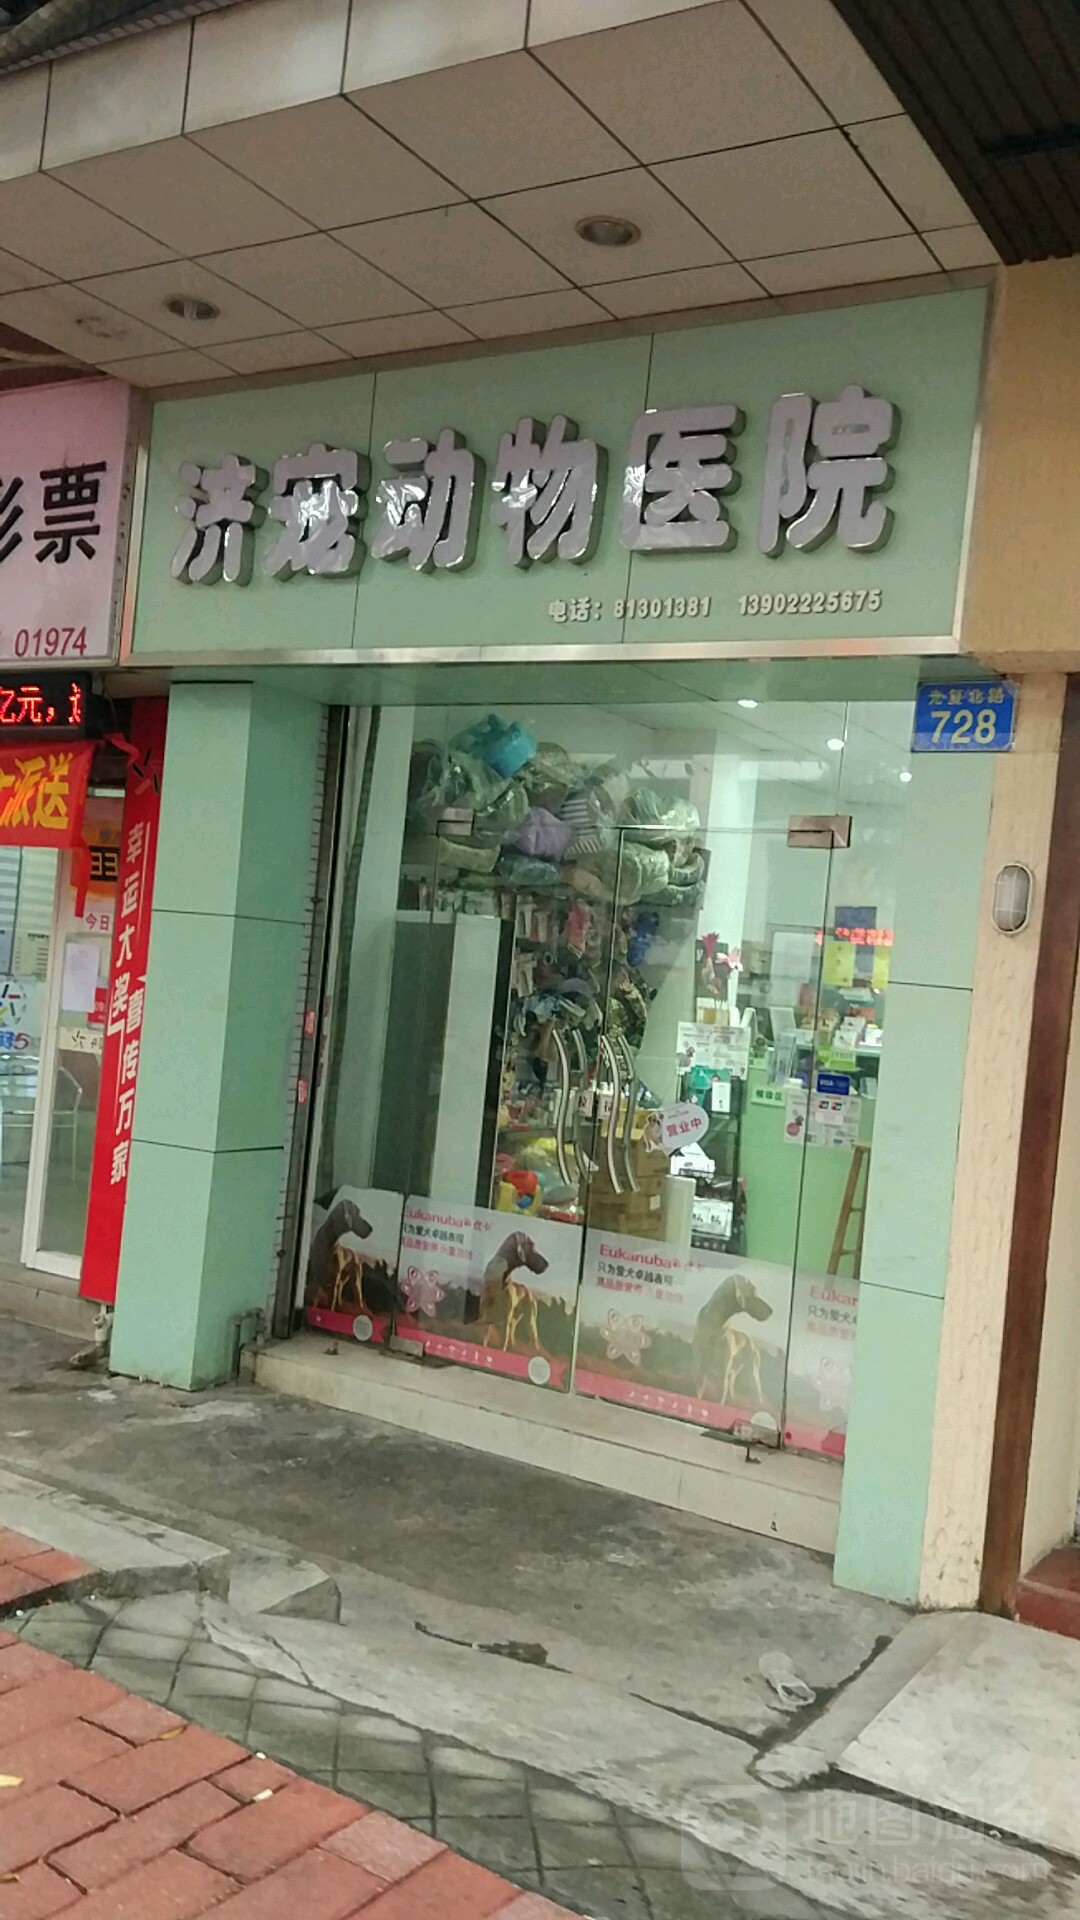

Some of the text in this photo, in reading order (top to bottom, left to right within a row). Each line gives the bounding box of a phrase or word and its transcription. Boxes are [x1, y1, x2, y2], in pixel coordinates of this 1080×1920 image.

[170, 385, 895, 588] 济宠动物医院
[613, 596, 711, 618] 81301381
[738, 589, 883, 615] 13902225675
[15, 627, 87, 657] 01974
[931, 709, 997, 744] 728
[666, 1117, 702, 1138] 营业中
